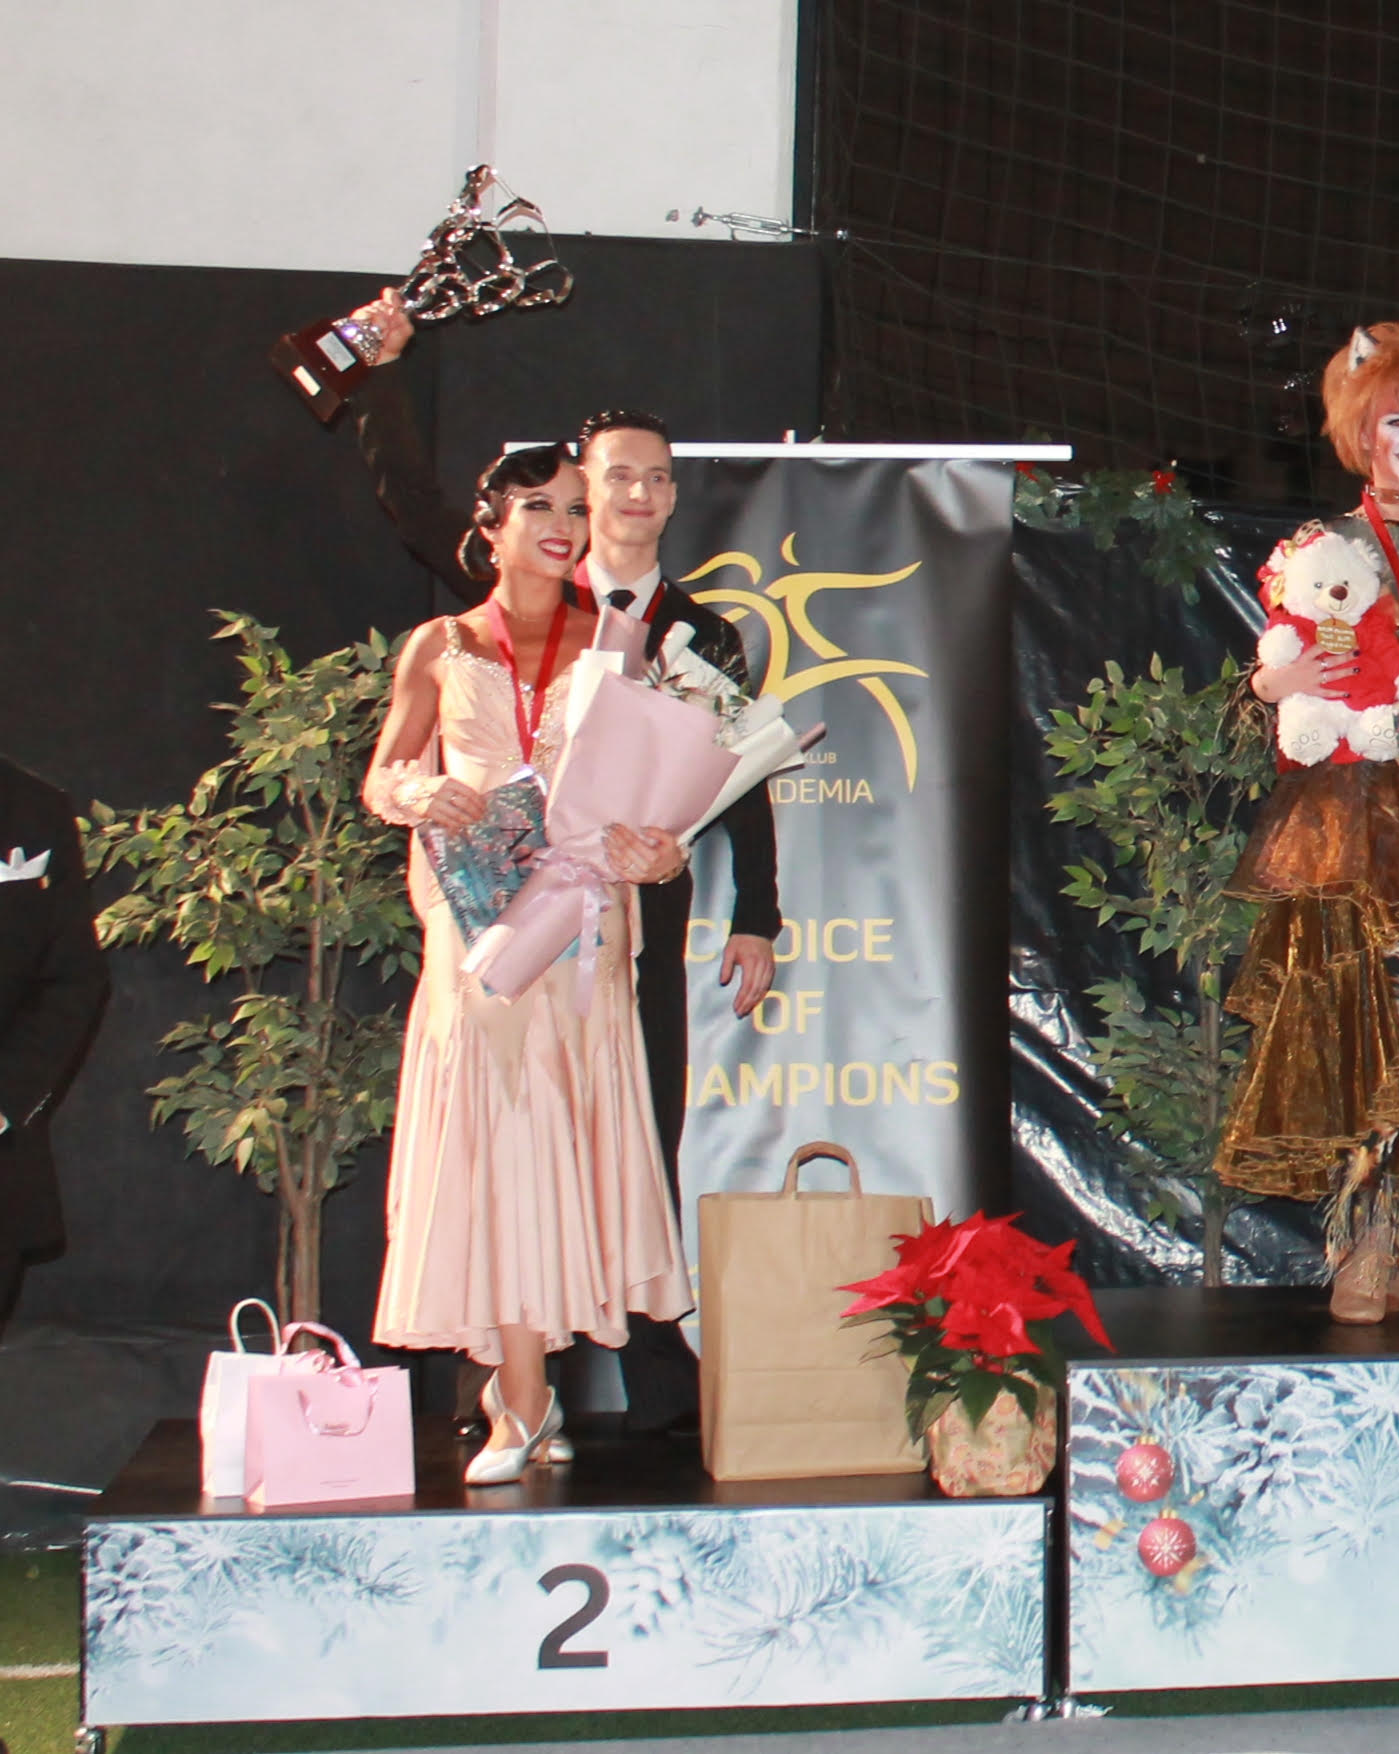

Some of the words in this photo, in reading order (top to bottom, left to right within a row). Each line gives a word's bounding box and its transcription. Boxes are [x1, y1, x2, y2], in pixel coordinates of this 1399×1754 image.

[684, 918, 894, 962] COICE
[752, 990, 824, 1035] OF
[686, 1060, 960, 1107] AMPIONS
[537, 1563, 610, 1670] 2
